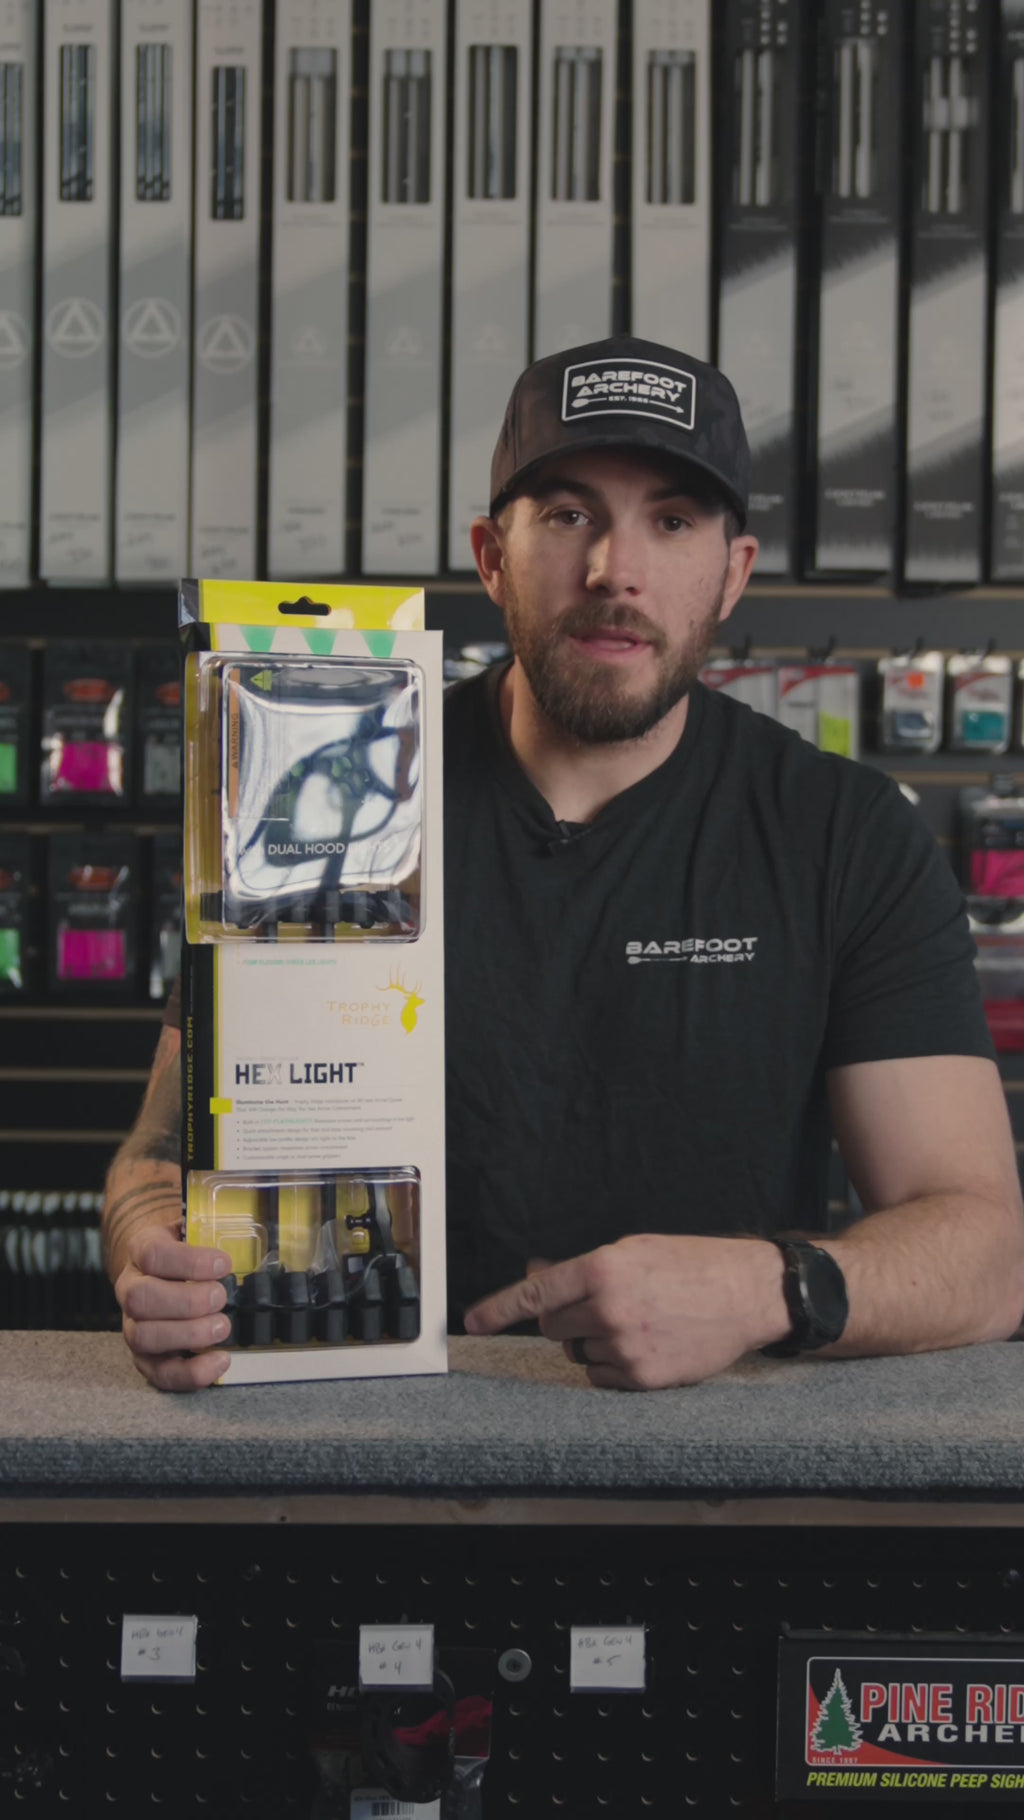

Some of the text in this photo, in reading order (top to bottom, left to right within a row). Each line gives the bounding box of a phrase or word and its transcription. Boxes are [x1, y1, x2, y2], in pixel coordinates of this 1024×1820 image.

[571, 370, 687, 392] BAREFOOT
[576, 382, 680, 402] ARCHERY
[231, 712, 239, 760] WARNING
[268, 844, 302, 855] DUAL
[305, 843, 346, 854] HOOD
[626, 937, 758, 955] BAREFOOT
[690, 953, 755, 963] ARCHERY
[327, 1000, 391, 1012] TROPHY
[342, 1014, 391, 1026] RIDGE
[235, 1063, 282, 1085] HEX
[186, 1016, 194, 1161] TROPHYRIDGE.COM
[860, 1683, 953, 1723] PINE
[877, 1724, 1024, 1743] ARCHE
[807, 1772, 877, 1787] PREMIUM
[880, 1773, 948, 1788] SILICONE
[950, 1774, 988, 1788] PEEP
